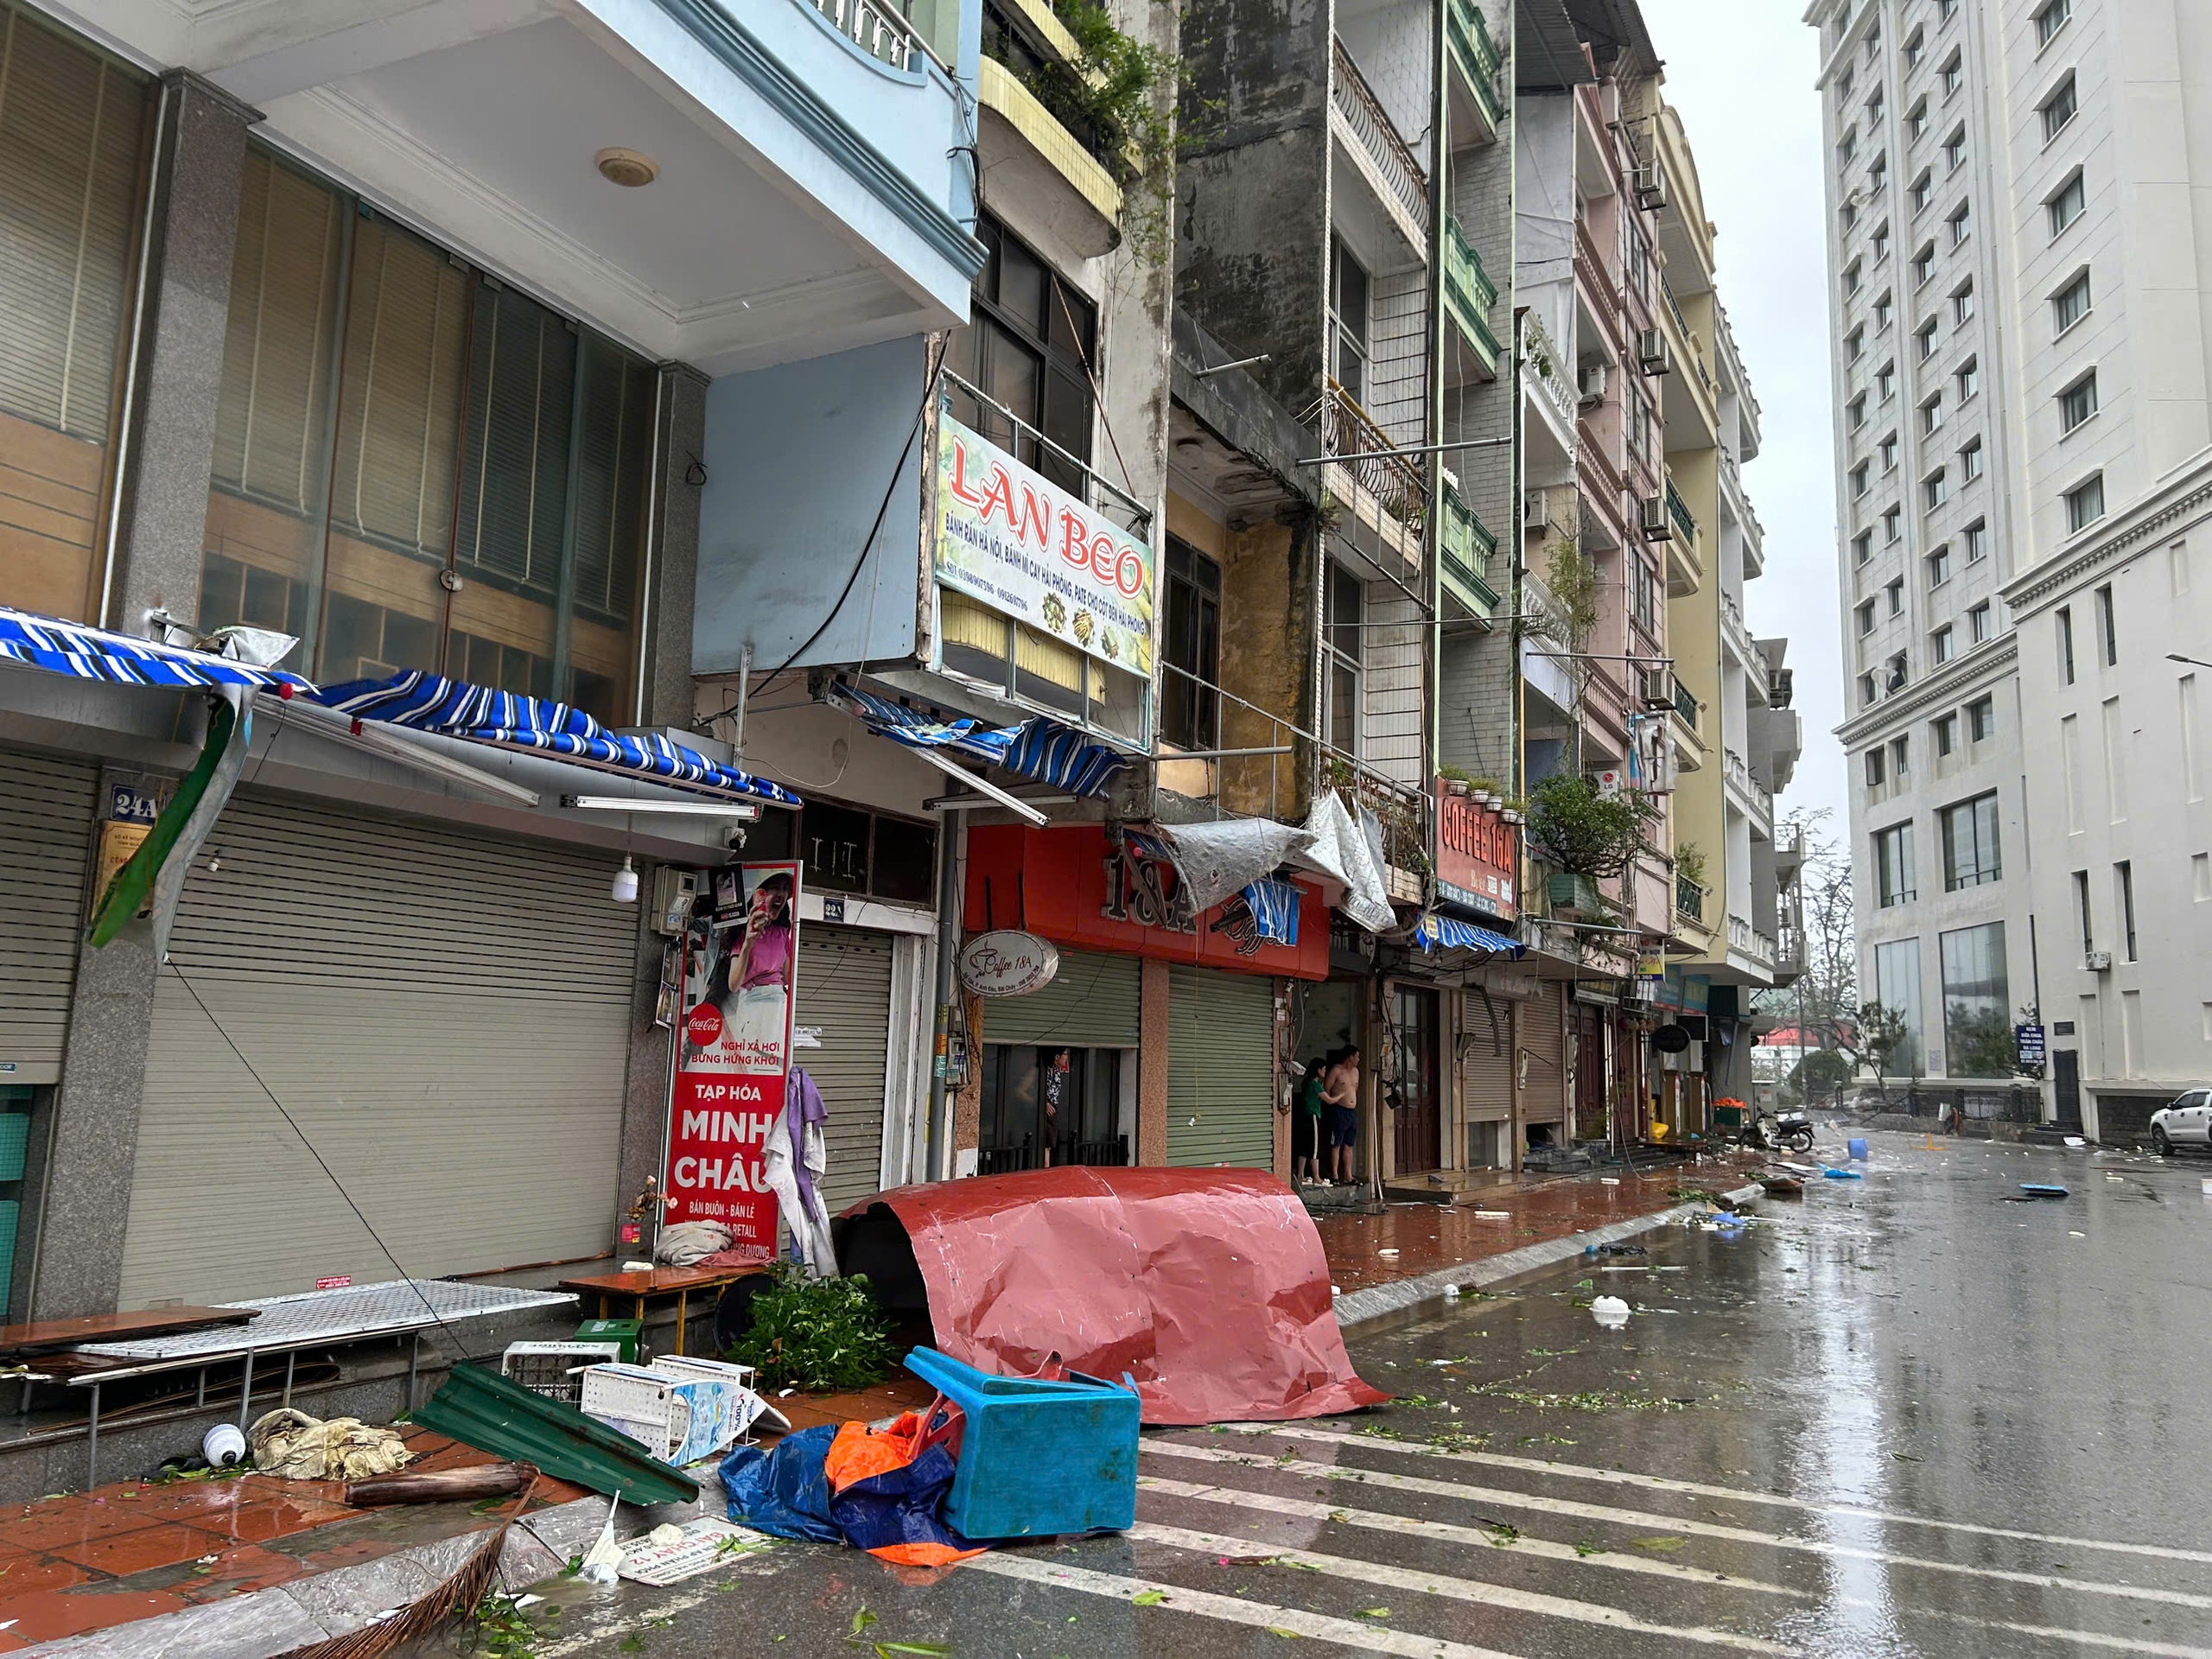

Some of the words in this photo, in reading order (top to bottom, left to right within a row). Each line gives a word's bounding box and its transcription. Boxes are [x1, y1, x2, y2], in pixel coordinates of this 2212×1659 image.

[950, 435, 1051, 550] LAN
[946, 511, 963, 537] BÁNH
[964, 522, 977, 547] RÁN
[979, 530, 988, 553] HÀ
[1005, 543, 1021, 570] BÁNH
[1029, 560, 1041, 582] CAY
[1042, 563, 1052, 587] HẢI
[116, 794, 157, 818] 24A
[1442, 798, 1487, 862] COFFEE
[984, 954, 1012, 978] Coffee
[1014, 956, 1032, 969] 18A
[721, 1039, 746, 1051] NGHỈ
[747, 1039, 760, 1052] XẢ
[761, 1041, 779, 1052] HƠI
[691, 1053, 721, 1064] BỪNG
[723, 1053, 752, 1065] HỨNG
[754, 1053, 779, 1065] KHỞI
[696, 1084, 726, 1102] TẠP
[729, 1084, 761, 1101] HÓA
[681, 1110, 772, 1144] MINH
[674, 1153, 772, 1194] CHÂU
[690, 1198, 704, 1214] BÁN
[704, 1200, 724, 1216] BUÔN
[730, 1202, 745, 1217] BÁN
[747, 1202, 755, 1218] LẺ
[628, 1556, 652, 1566] 12
